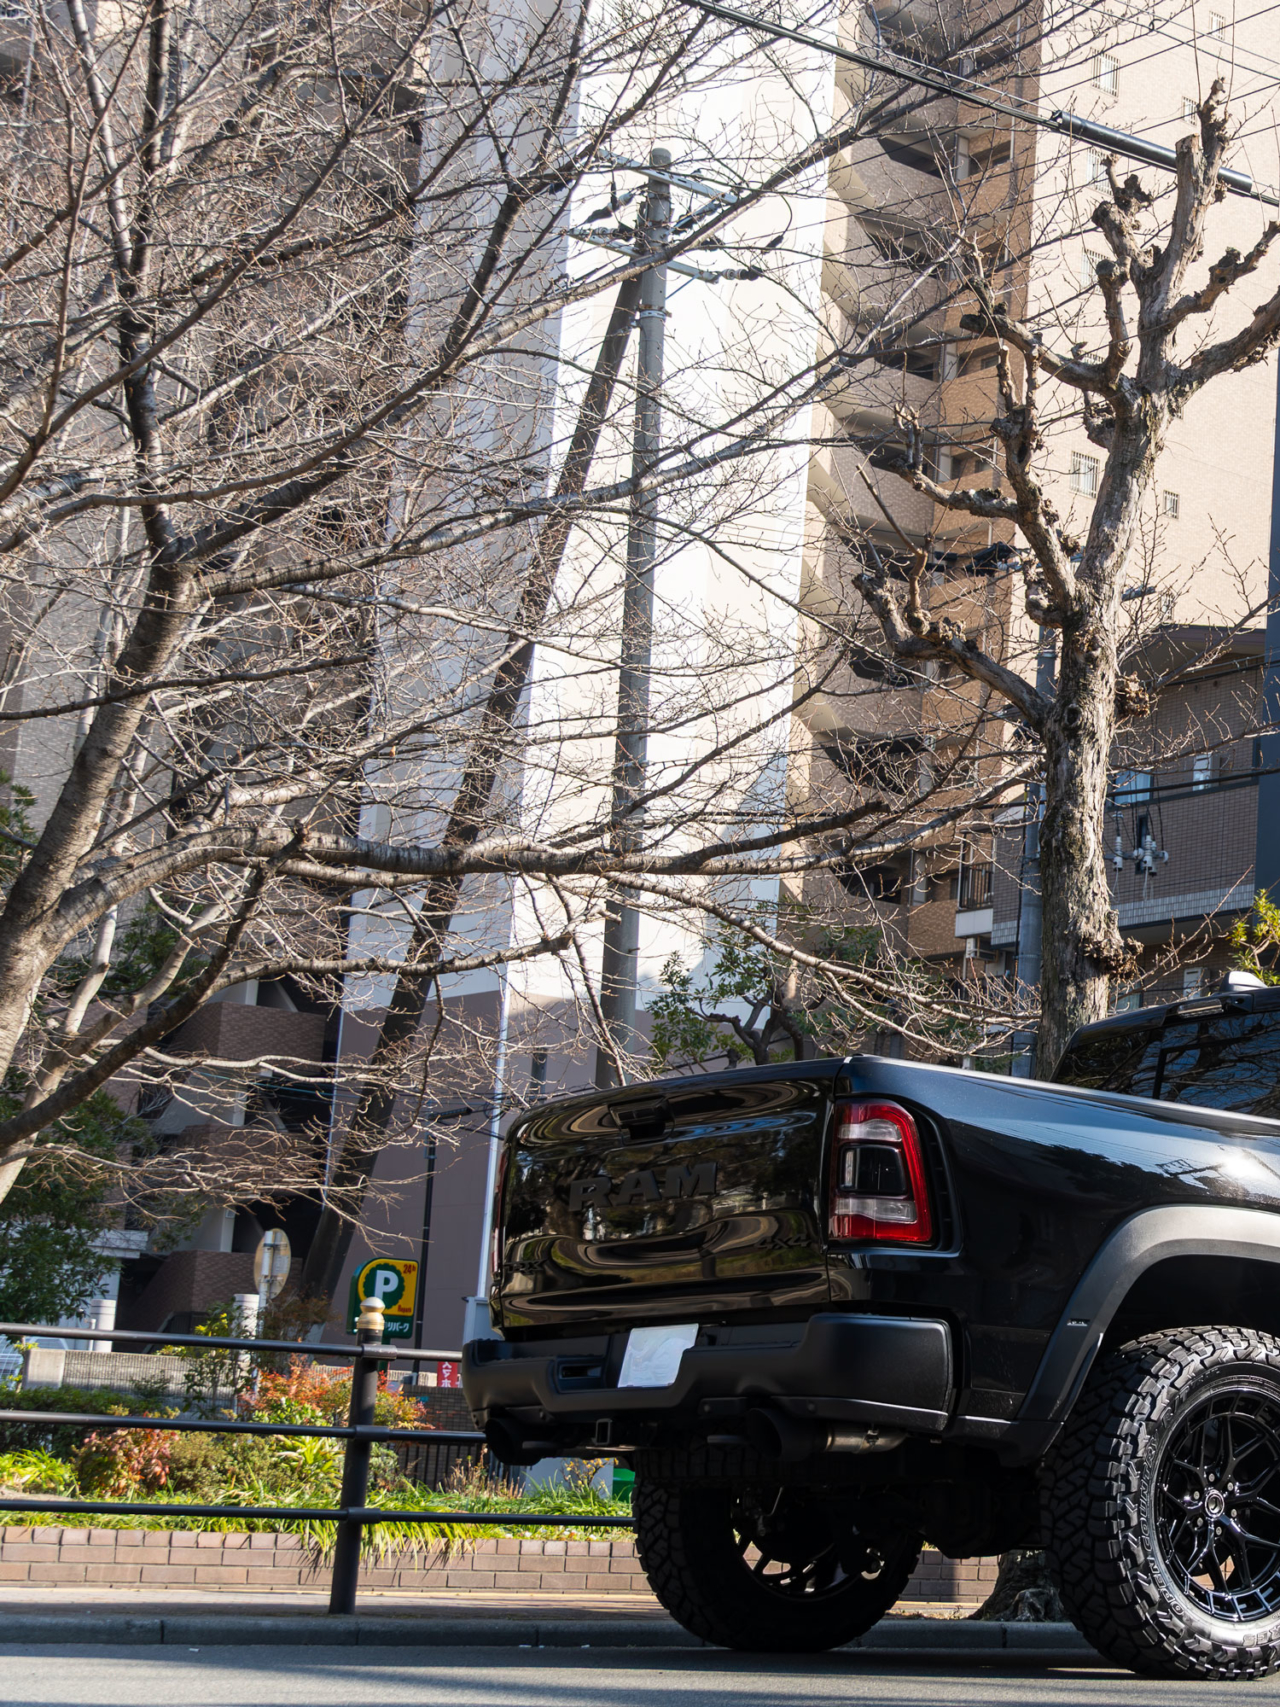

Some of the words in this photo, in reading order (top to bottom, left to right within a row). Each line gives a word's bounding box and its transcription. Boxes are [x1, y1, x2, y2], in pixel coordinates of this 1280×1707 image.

[568, 1162, 718, 1212] RAM
[374, 1269, 399, 1300] P
[384, 1321, 409, 1332] リパーク
